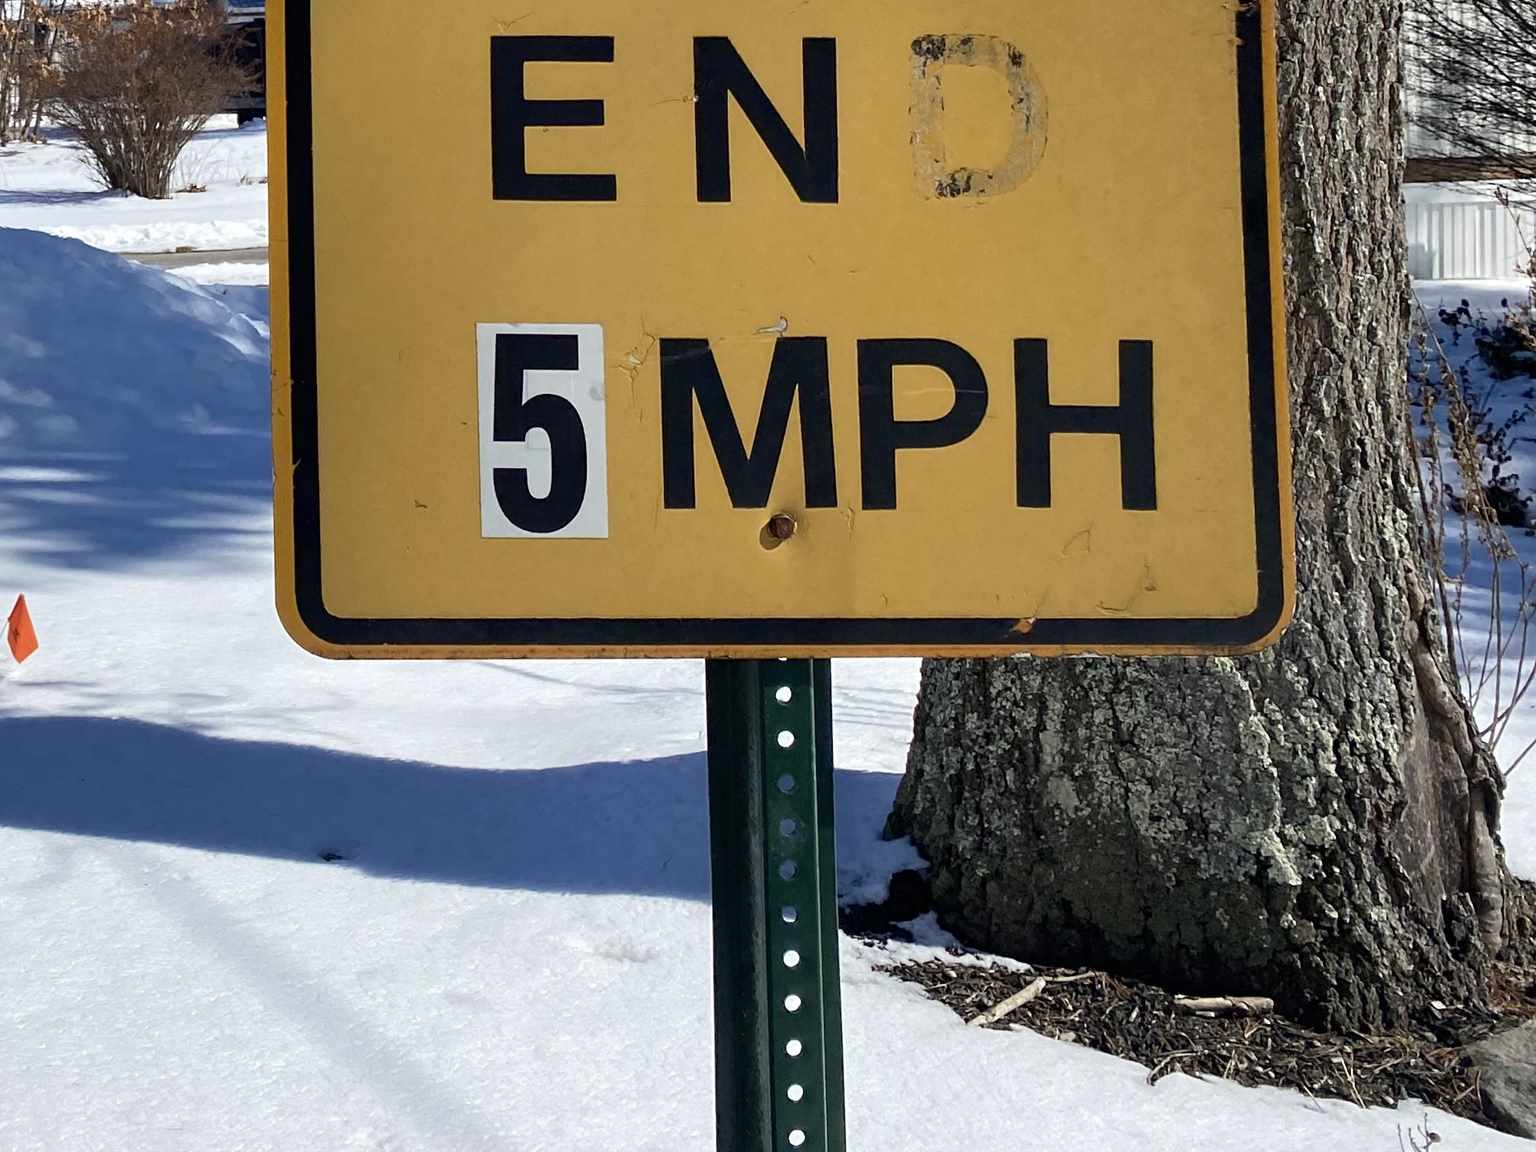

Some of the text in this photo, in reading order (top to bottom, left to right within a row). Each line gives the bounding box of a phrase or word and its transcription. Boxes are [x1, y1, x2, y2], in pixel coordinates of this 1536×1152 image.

[490, 34, 1049, 204] END
[491, 333, 1159, 534] 5 MPH
